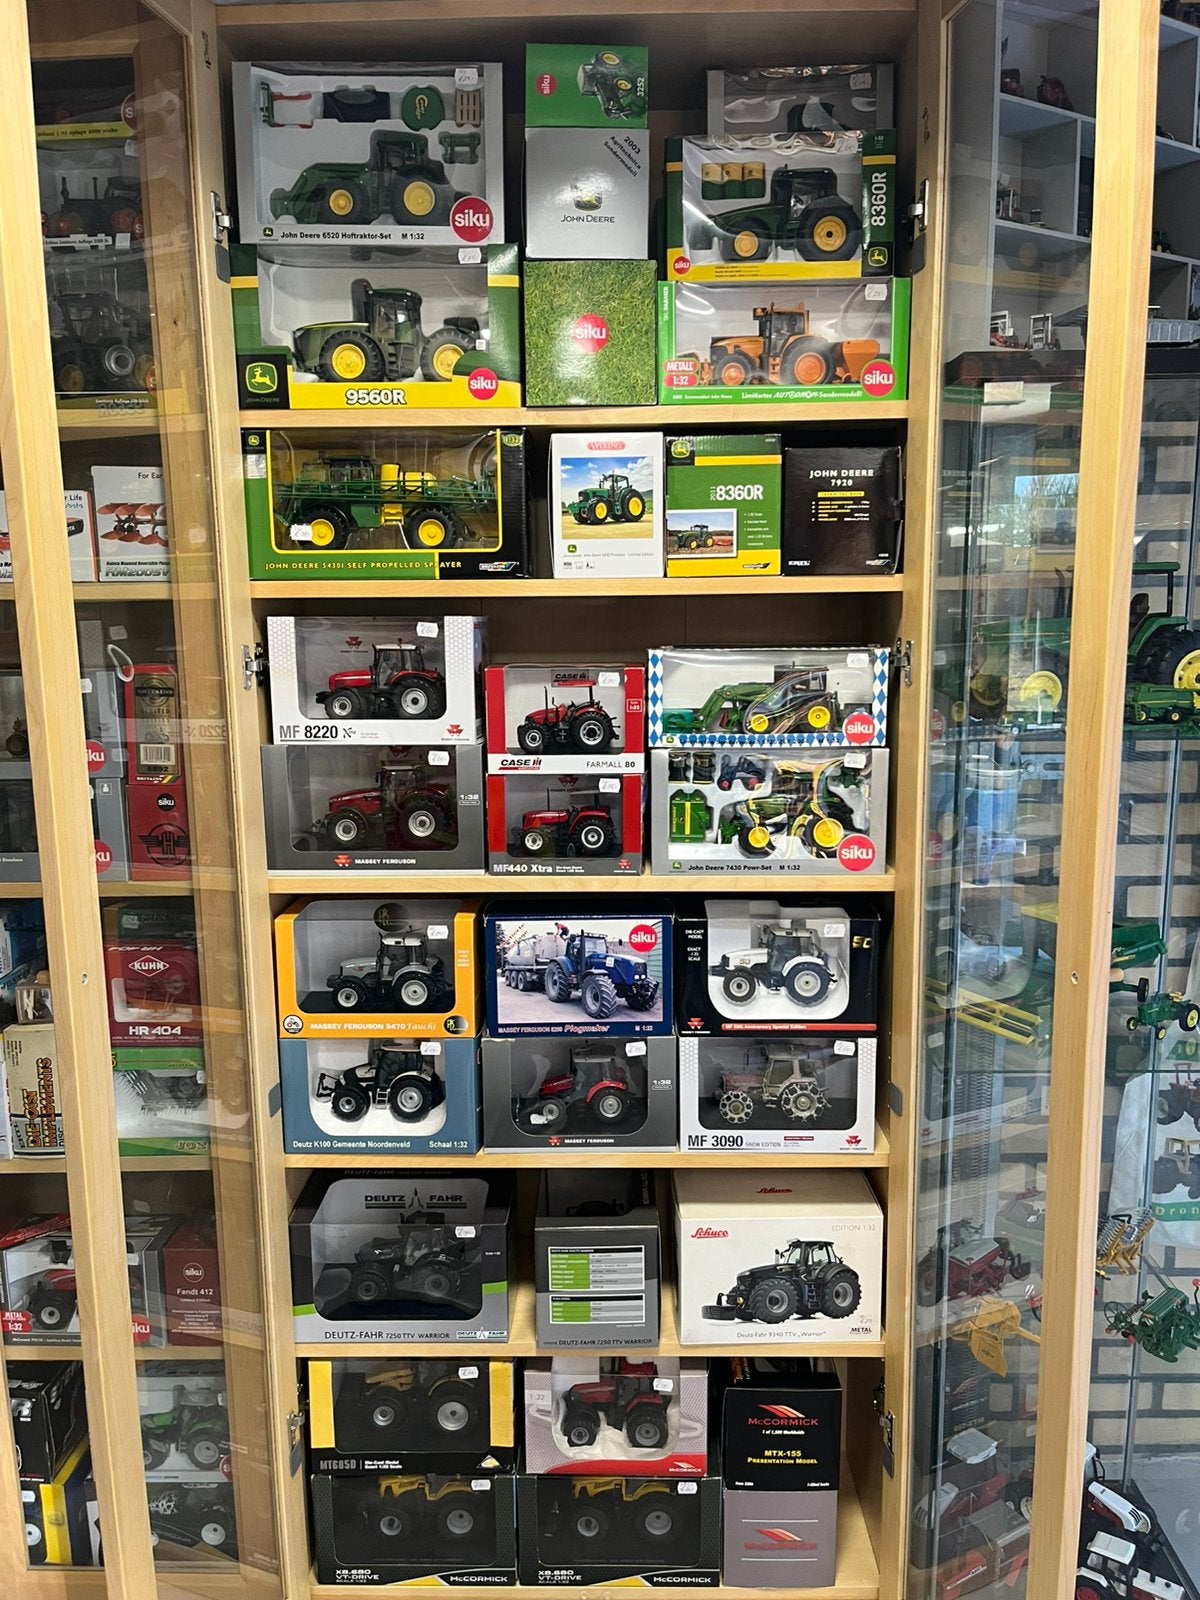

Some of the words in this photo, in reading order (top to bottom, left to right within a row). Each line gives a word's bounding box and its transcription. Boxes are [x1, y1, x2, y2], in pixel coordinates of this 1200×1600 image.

[541, 75, 550, 94] siku
[637, 77, 645, 96] 3252
[624, 136, 641, 154] 2003
[870, 172, 887, 226] 8360R
[454, 212, 490, 229] siku
[561, 215, 584, 223] JOHN
[586, 215, 616, 223] DEERE
[280, 232, 298, 240] John
[300, 232, 321, 240] Deere
[322, 232, 340, 240] 6520
[341, 232, 392, 240] Hoftraktor-Set
[402, 232, 408, 240] M
[410, 232, 424, 240] 1:32
[574, 324, 607, 340] siku
[666, 361, 694, 370] METALL
[470, 377, 496, 390] siku
[672, 376, 689, 386] 1:32
[864, 373, 893, 384] siku
[345, 389, 406, 405] 9560R
[590, 441, 623, 450] WIKING
[809, 470, 838, 478] JOHN
[841, 469, 874, 477] DEERE
[716, 484, 764, 500] 8360R
[280, 726, 300, 739] MF
[304, 726, 338, 739] 8220
[846, 722, 874, 734] siku
[86, 750, 105, 761] iku
[158, 798, 174, 806] siku
[840, 846, 872, 860] siku
[494, 864, 528, 872] MF440
[530, 864, 553, 872] Xtra
[630, 931, 655, 943] siku
[134, 962, 164, 970] KUHN
[129, 1026, 149, 1035] HR
[152, 1026, 181, 1035] 404
[343, 1022, 385, 1030] FERGUSON
[36, 1058, 57, 1147] IMPLEMENTS
[293, 1140, 312, 1148] Deutz
[314, 1140, 331, 1148] K100
[332, 1140, 366, 1148] Gemeente
[368, 1140, 411, 1148] Noordenveld
[429, 1140, 452, 1148] Schaal
[454, 1140, 468, 1148] 1:32
[688, 1135, 708, 1147] MF
[711, 1135, 743, 1147] 3090
[364, 1194, 405, 1202] DEUTZ
[430, 1194, 463, 1202] FAHR
[690, 1227, 729, 1239] Schuco
[185, 1268, 202, 1276] siku
[8, 1323, 22, 1331] 1:32
[132, 1323, 150, 1334] iku
[325, 1331, 384, 1339] DEUTZ-FAHR
[748, 1418, 818, 1426] McCORMICK
